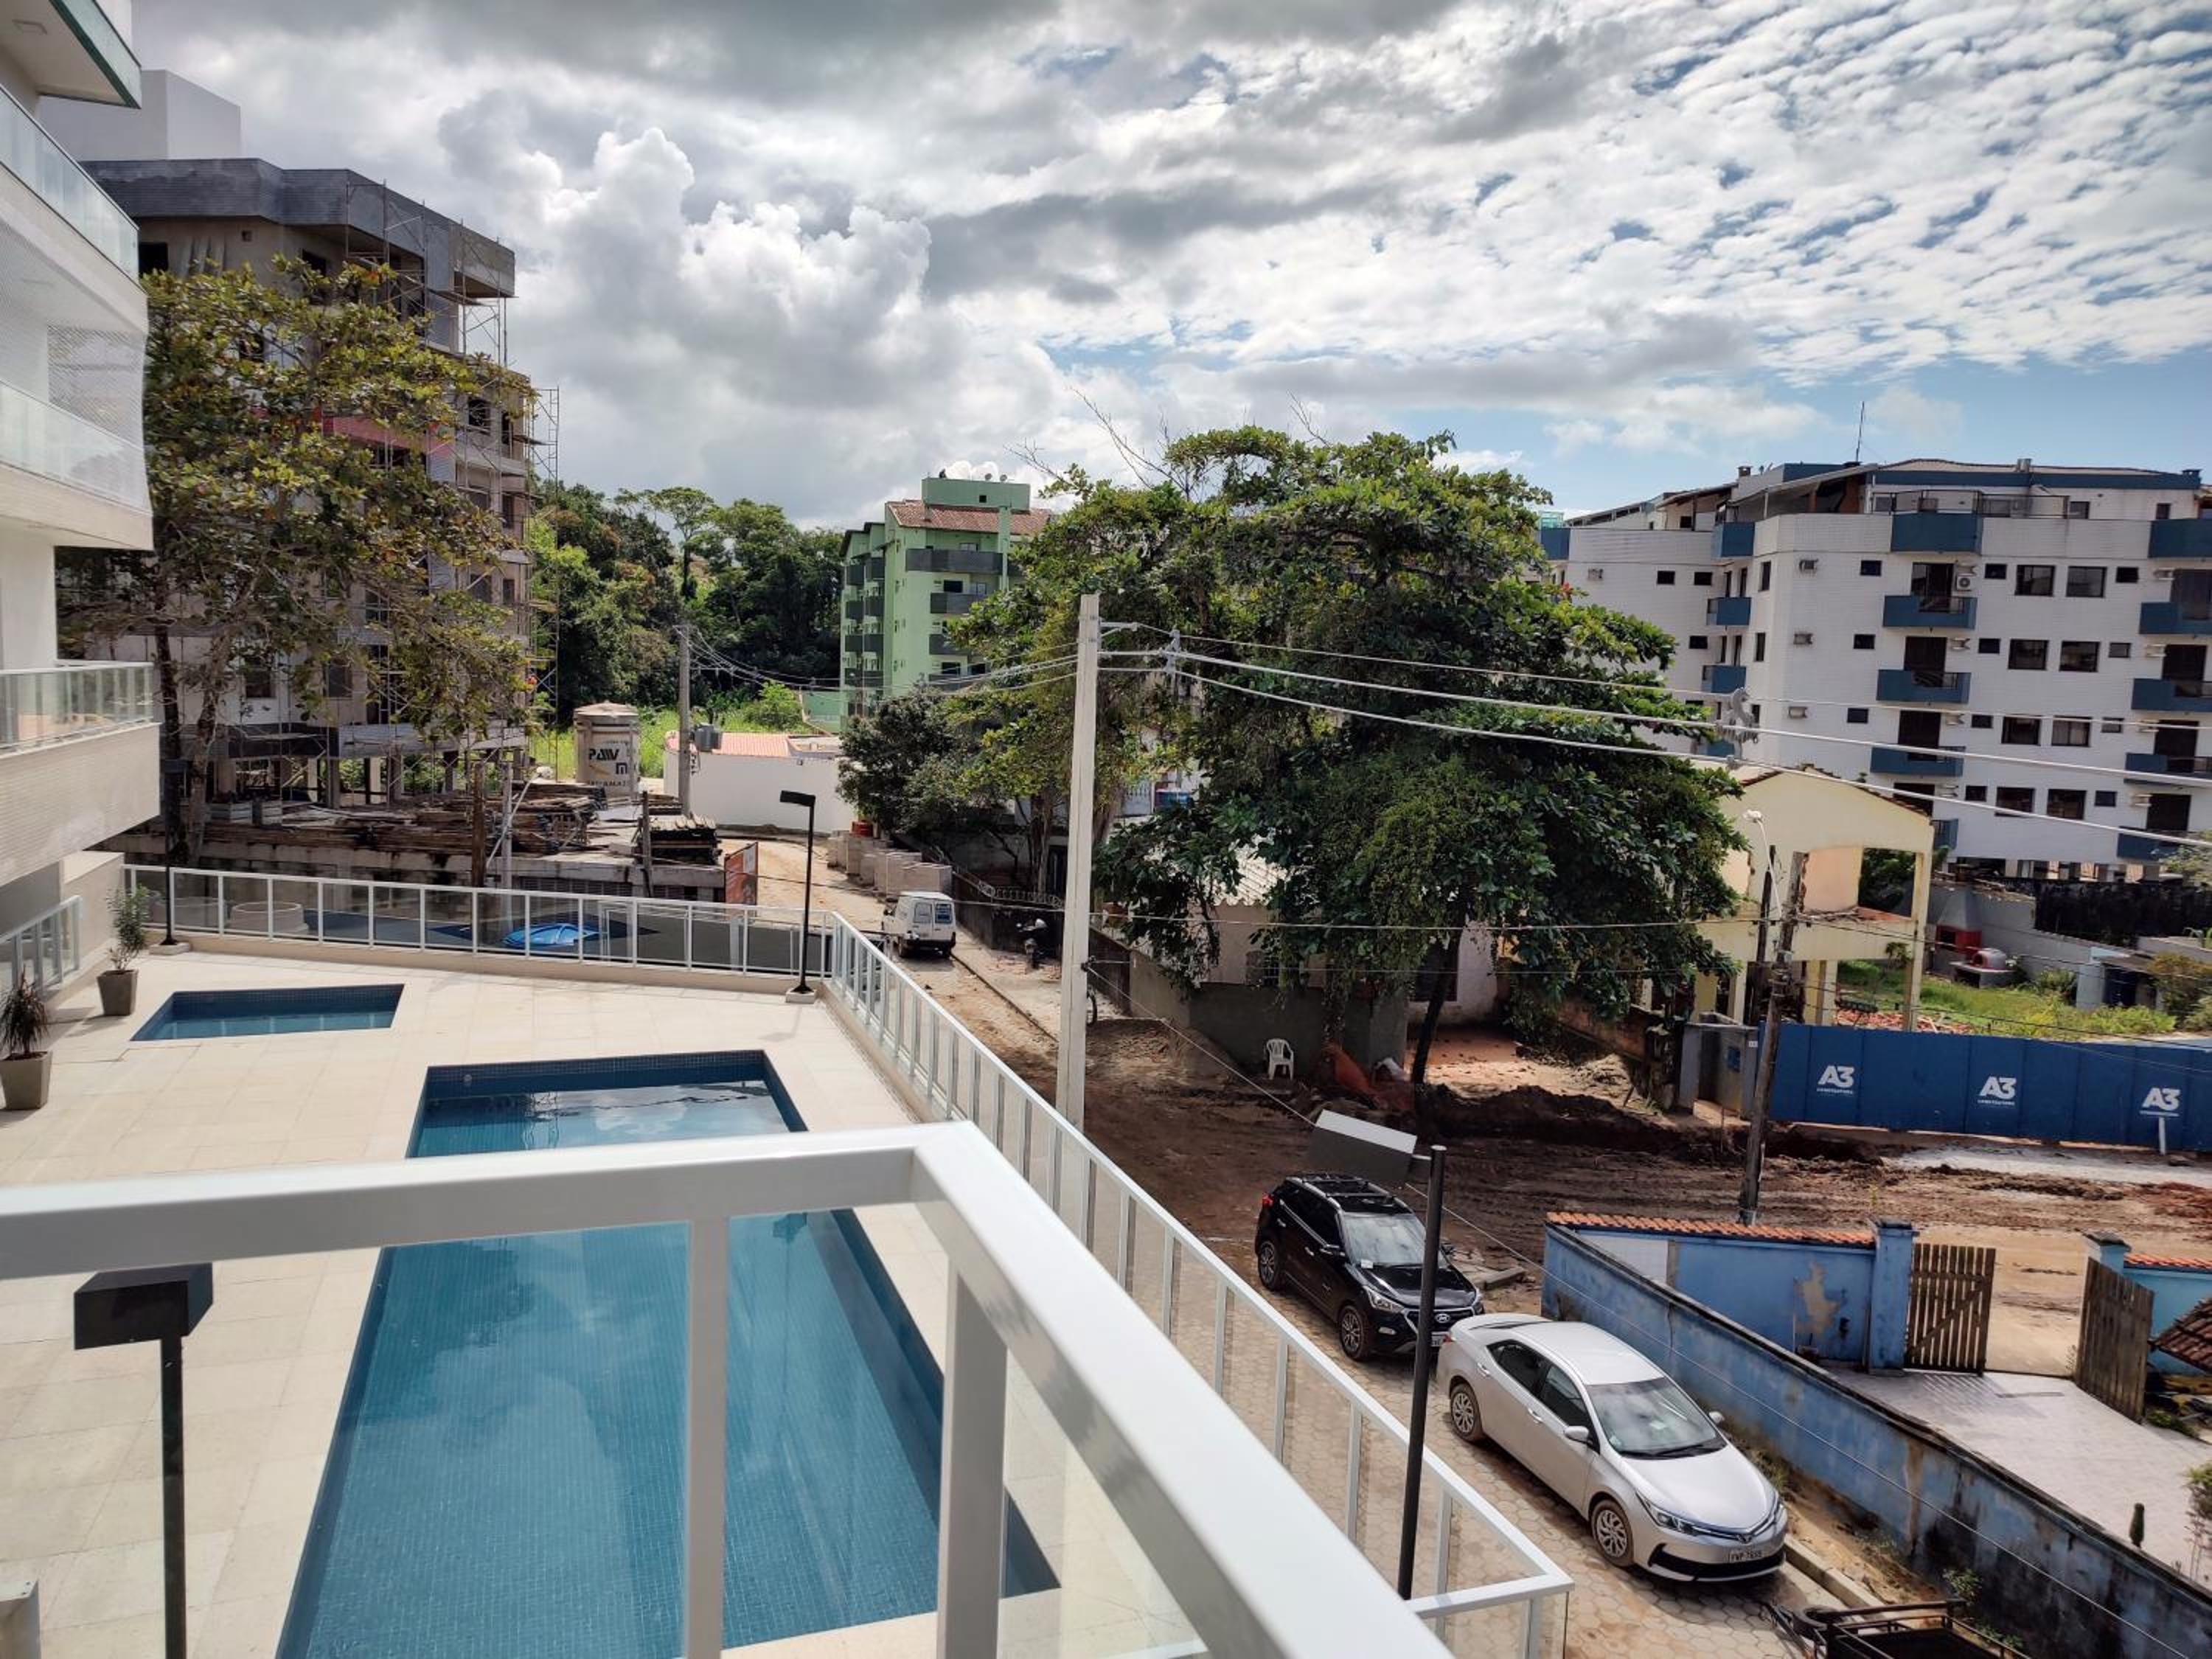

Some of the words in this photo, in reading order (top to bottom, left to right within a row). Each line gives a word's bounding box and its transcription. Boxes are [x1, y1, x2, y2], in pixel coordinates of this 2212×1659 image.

[1818, 1065, 1855, 1088] A3
[1979, 1076, 2017, 1099] A3
[2141, 1087, 2181, 1111] A3
